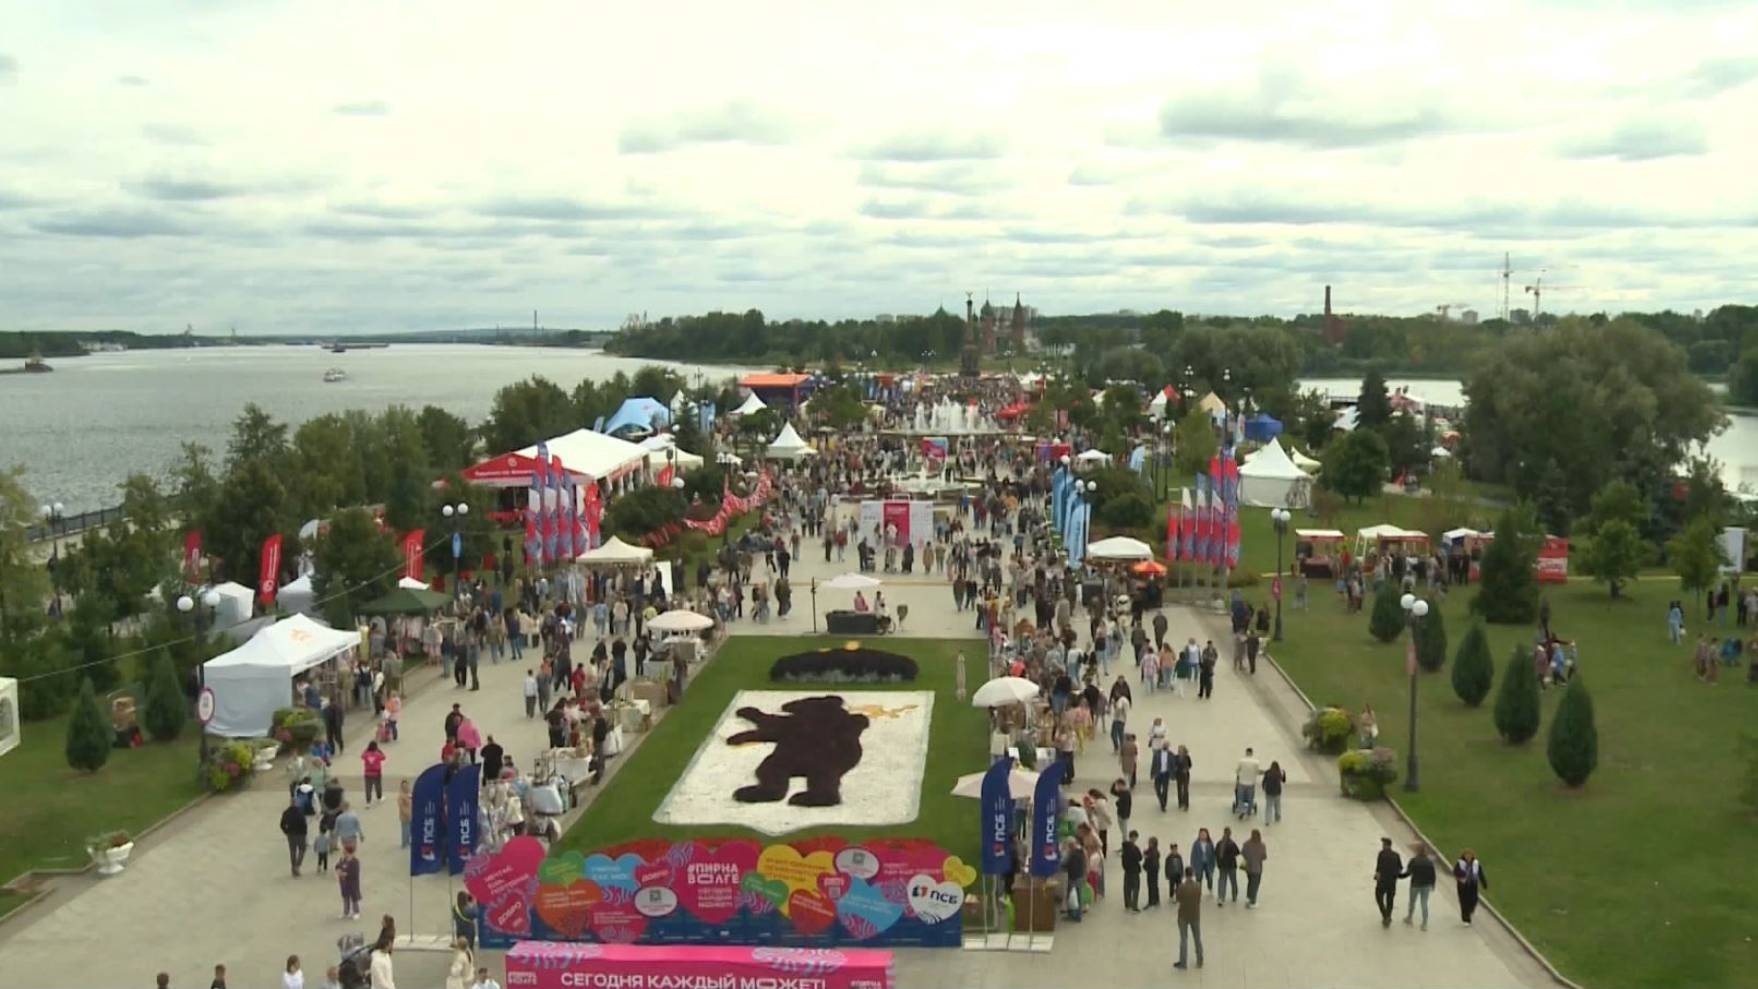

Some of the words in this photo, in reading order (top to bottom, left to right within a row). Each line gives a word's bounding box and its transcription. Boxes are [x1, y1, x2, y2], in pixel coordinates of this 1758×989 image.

[423, 818, 435, 844] ПСБ
[460, 818, 470, 844] ПСБ
[995, 814, 1005, 842] ПСБ
[1046, 815, 1055, 843] ПСБ
[687, 862, 739, 874] #ПИРНА
[687, 873, 740, 884] ВОЛГЕ
[930, 890, 958, 905] ПСБ
[561, 972, 643, 988] СЕГОДНЯ
[647, 971, 736, 989] КАЖДЫЙ
[741, 977, 826, 989] МОЖЕТ!
